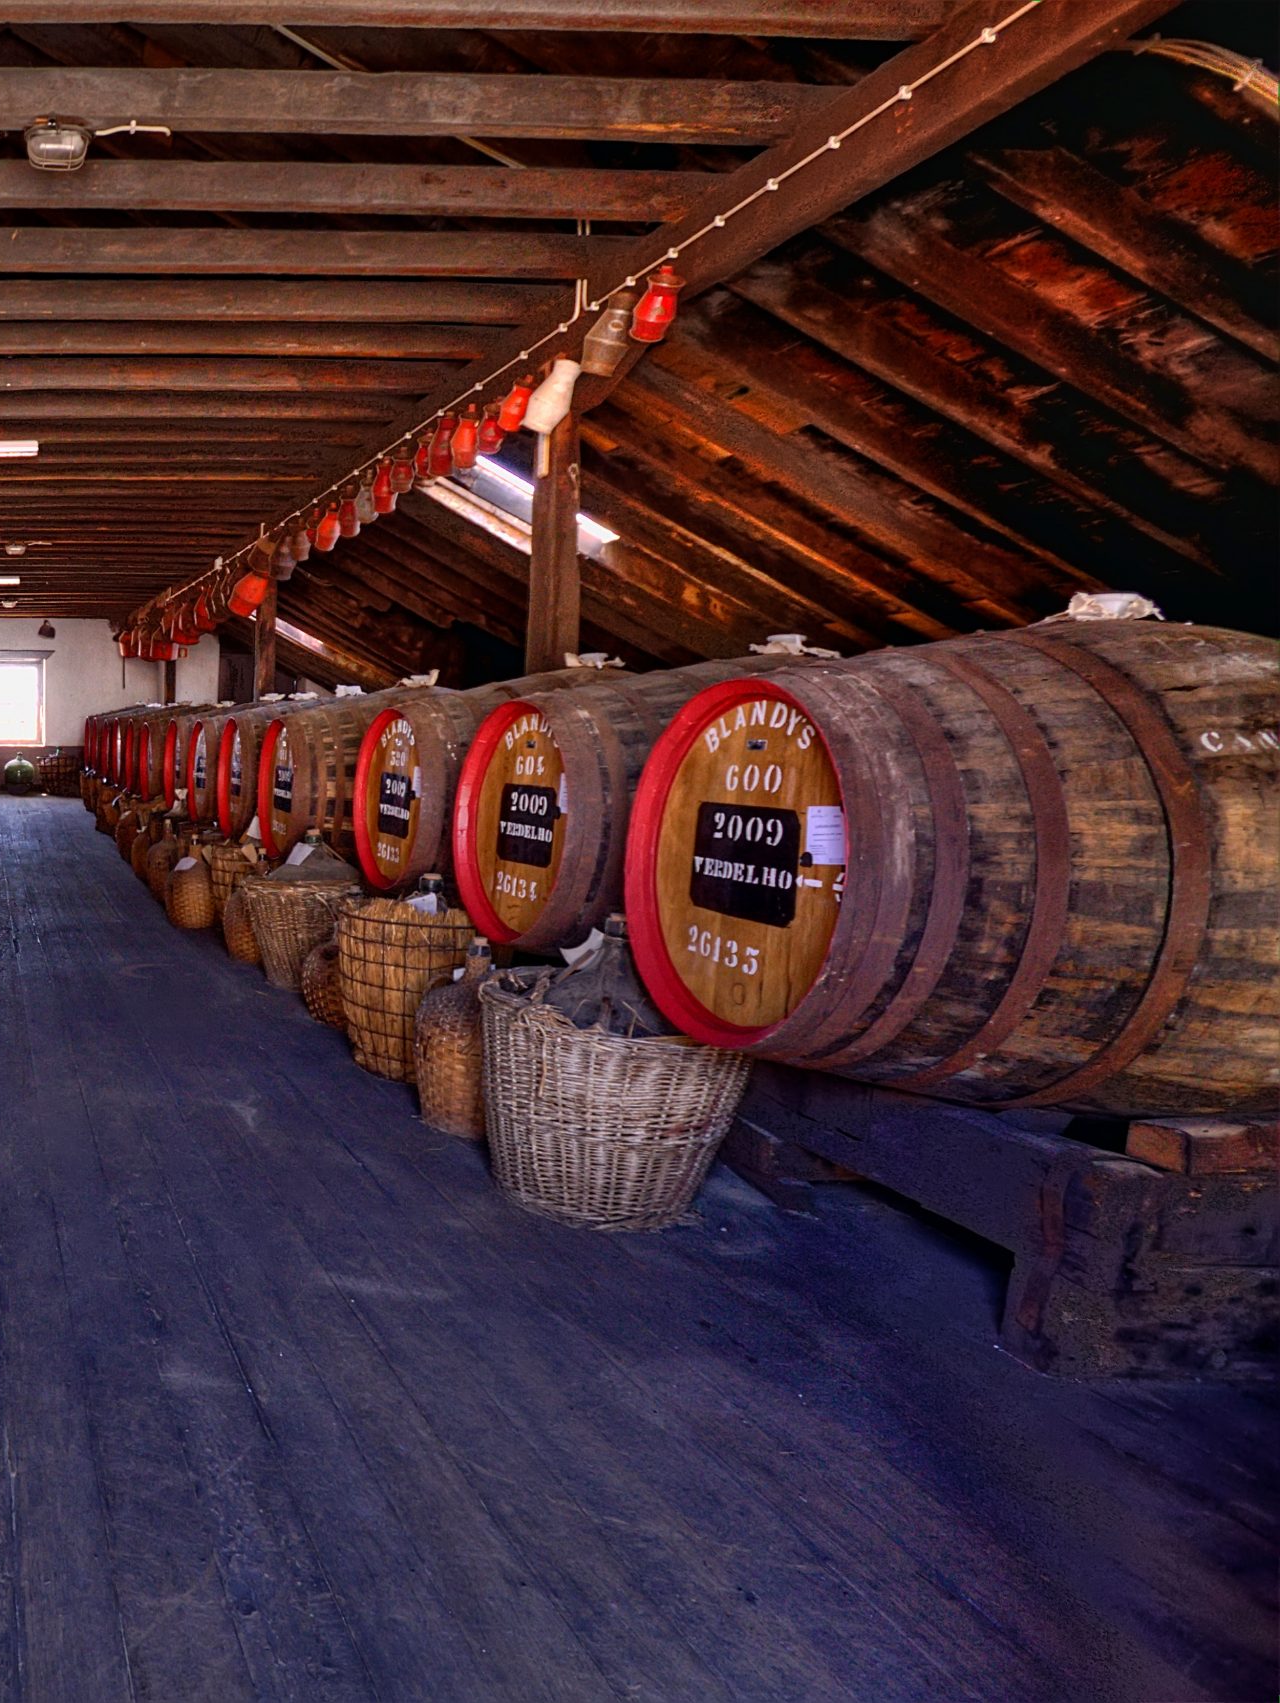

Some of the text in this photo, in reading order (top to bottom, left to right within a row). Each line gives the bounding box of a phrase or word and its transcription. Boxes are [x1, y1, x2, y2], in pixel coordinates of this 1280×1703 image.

[705, 699, 816, 752] BLANDY'S
[516, 755, 545, 775] 604
[725, 764, 782, 793] 600
[511, 791, 548, 816] 2009
[500, 820, 553, 843] VERDELHO
[714, 812, 784, 846] 2009
[496, 871, 537, 902] 26134
[693, 855, 793, 890] VERDELHO
[687, 925, 760, 975] 26135
